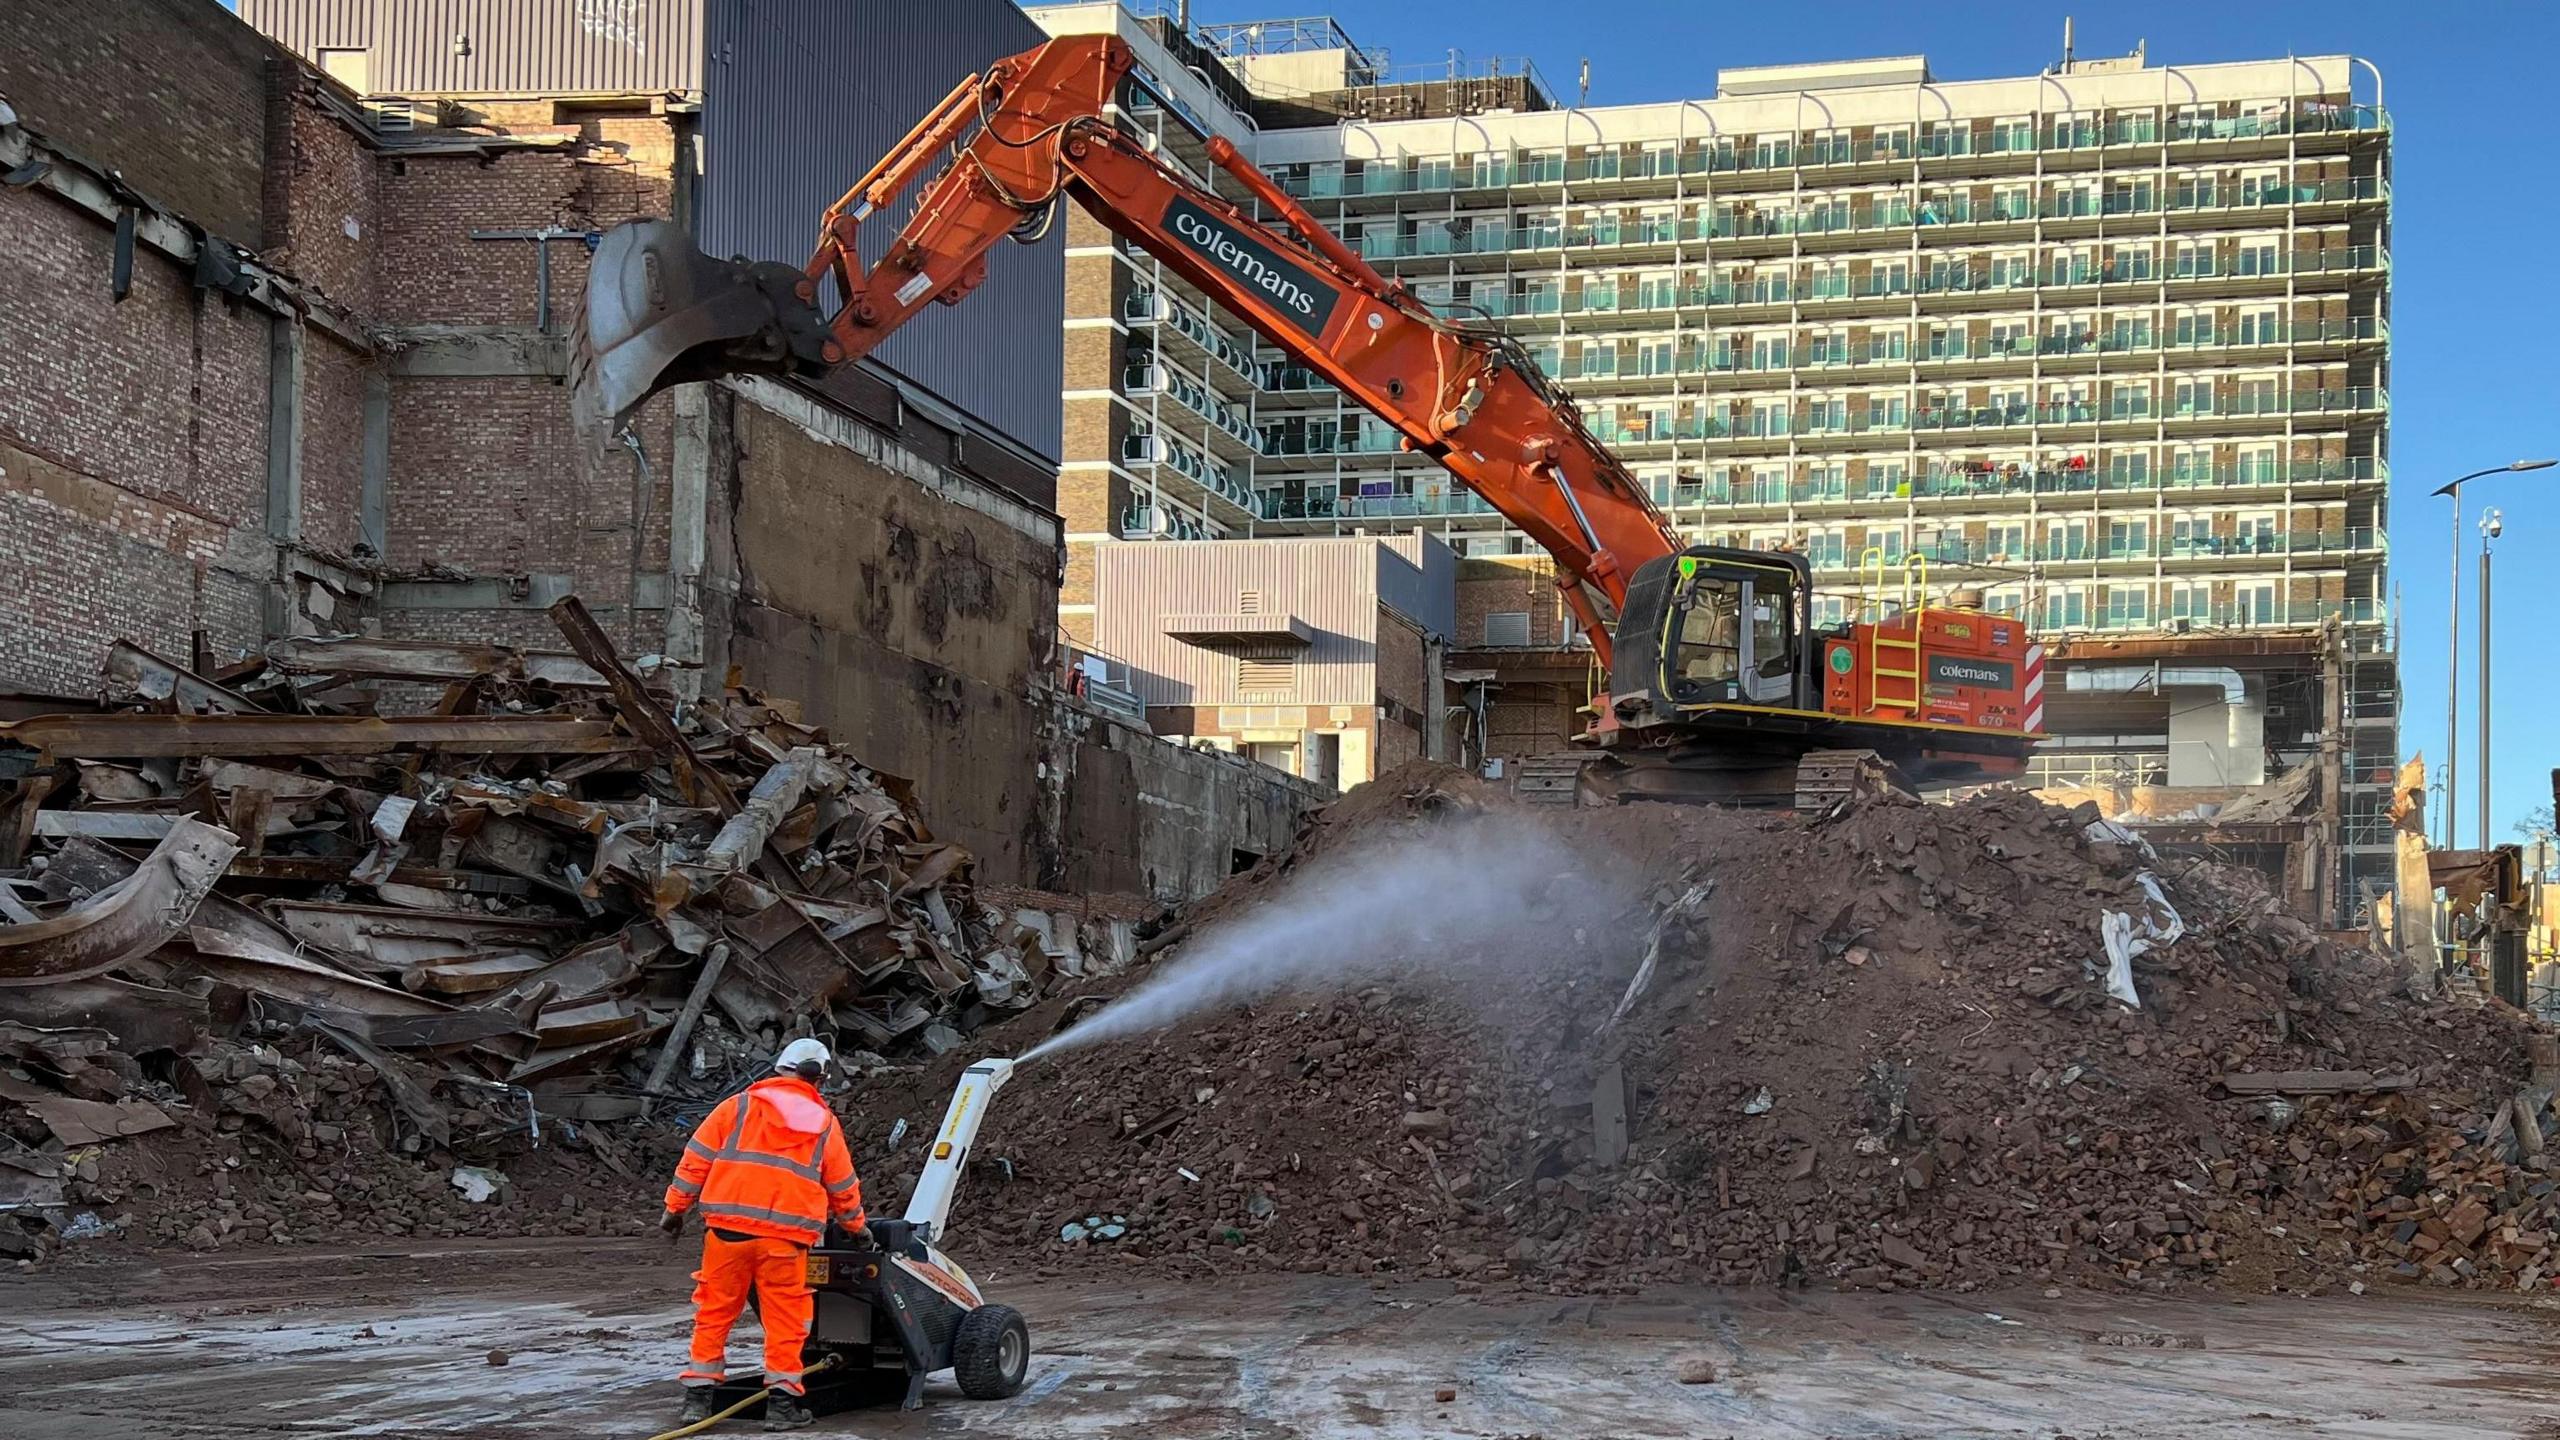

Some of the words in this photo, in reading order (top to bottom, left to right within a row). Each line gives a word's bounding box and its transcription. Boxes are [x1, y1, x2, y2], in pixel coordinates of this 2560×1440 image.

[1176, 213, 1314, 314] colemans
[1940, 664, 1999, 682] colemans
[1978, 715, 2003, 727] 670
